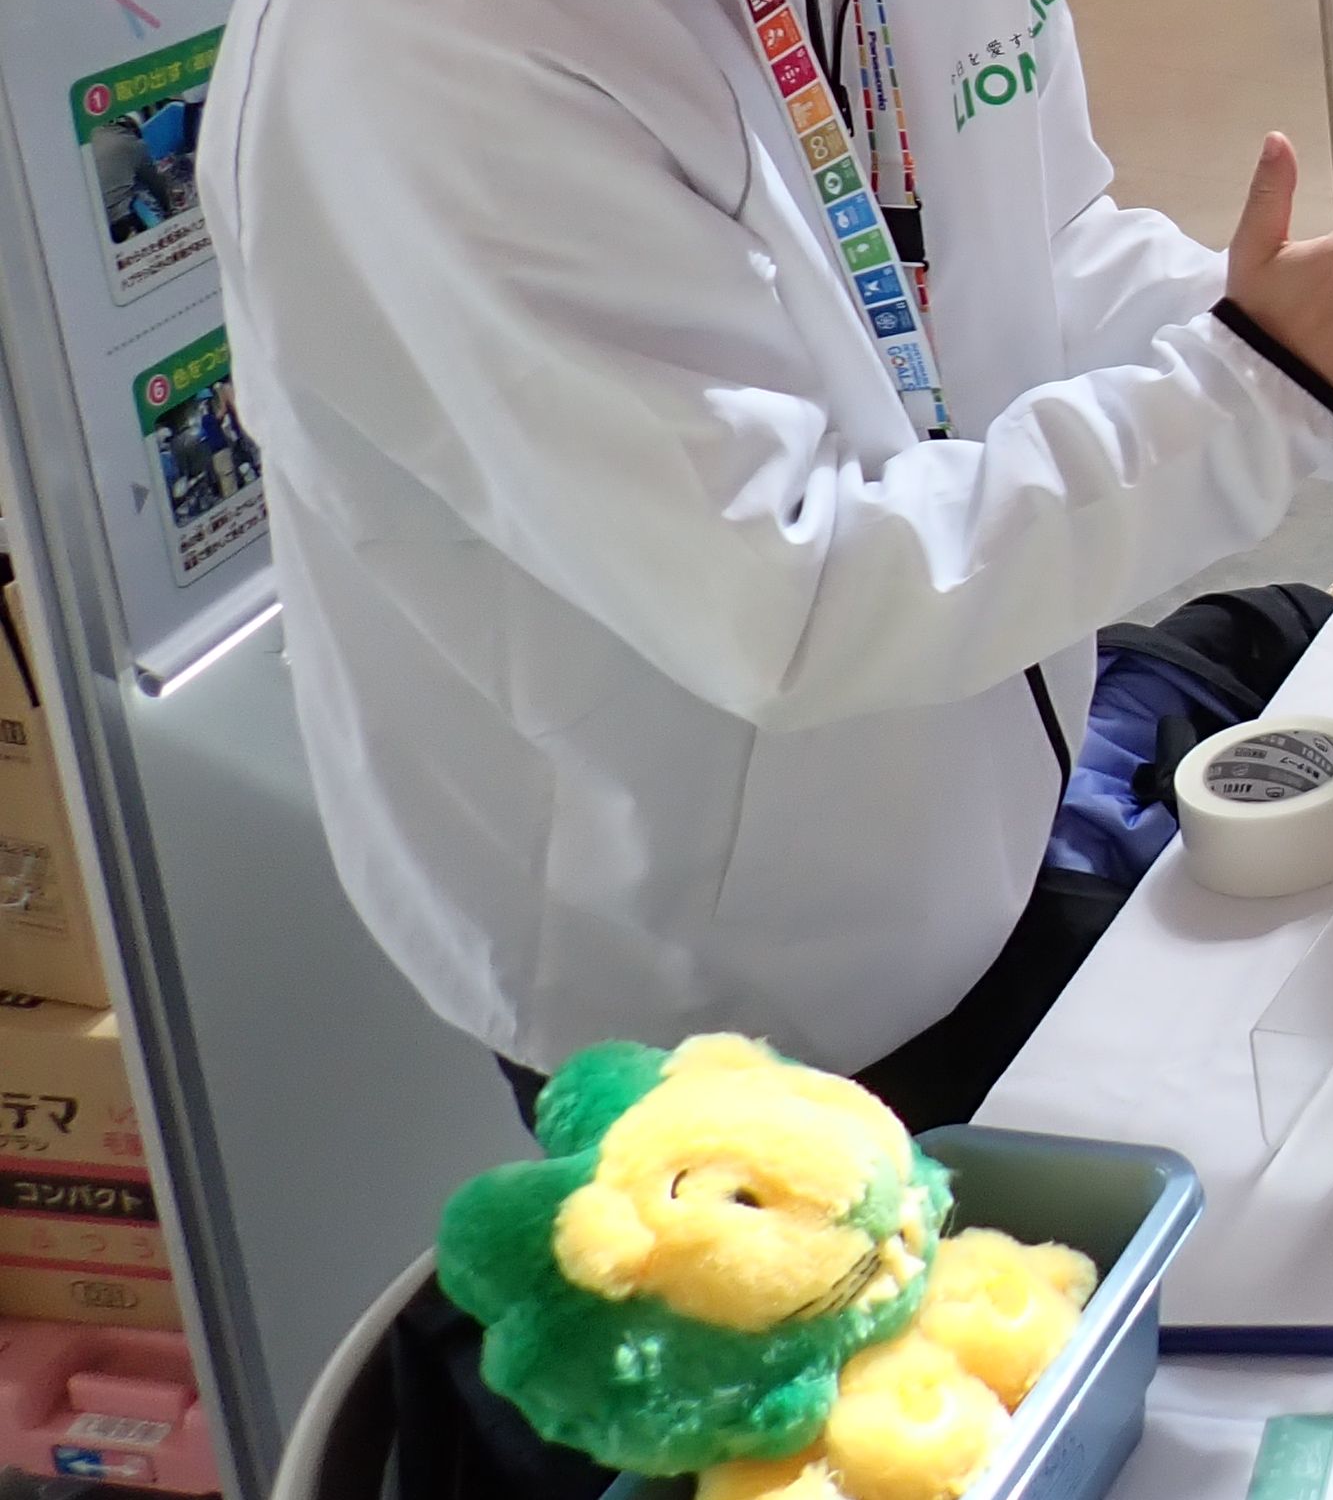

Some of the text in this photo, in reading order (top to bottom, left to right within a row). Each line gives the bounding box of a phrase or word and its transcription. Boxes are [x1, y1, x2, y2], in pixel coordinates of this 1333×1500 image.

[14, 1181, 143, 1212] コンパクト
